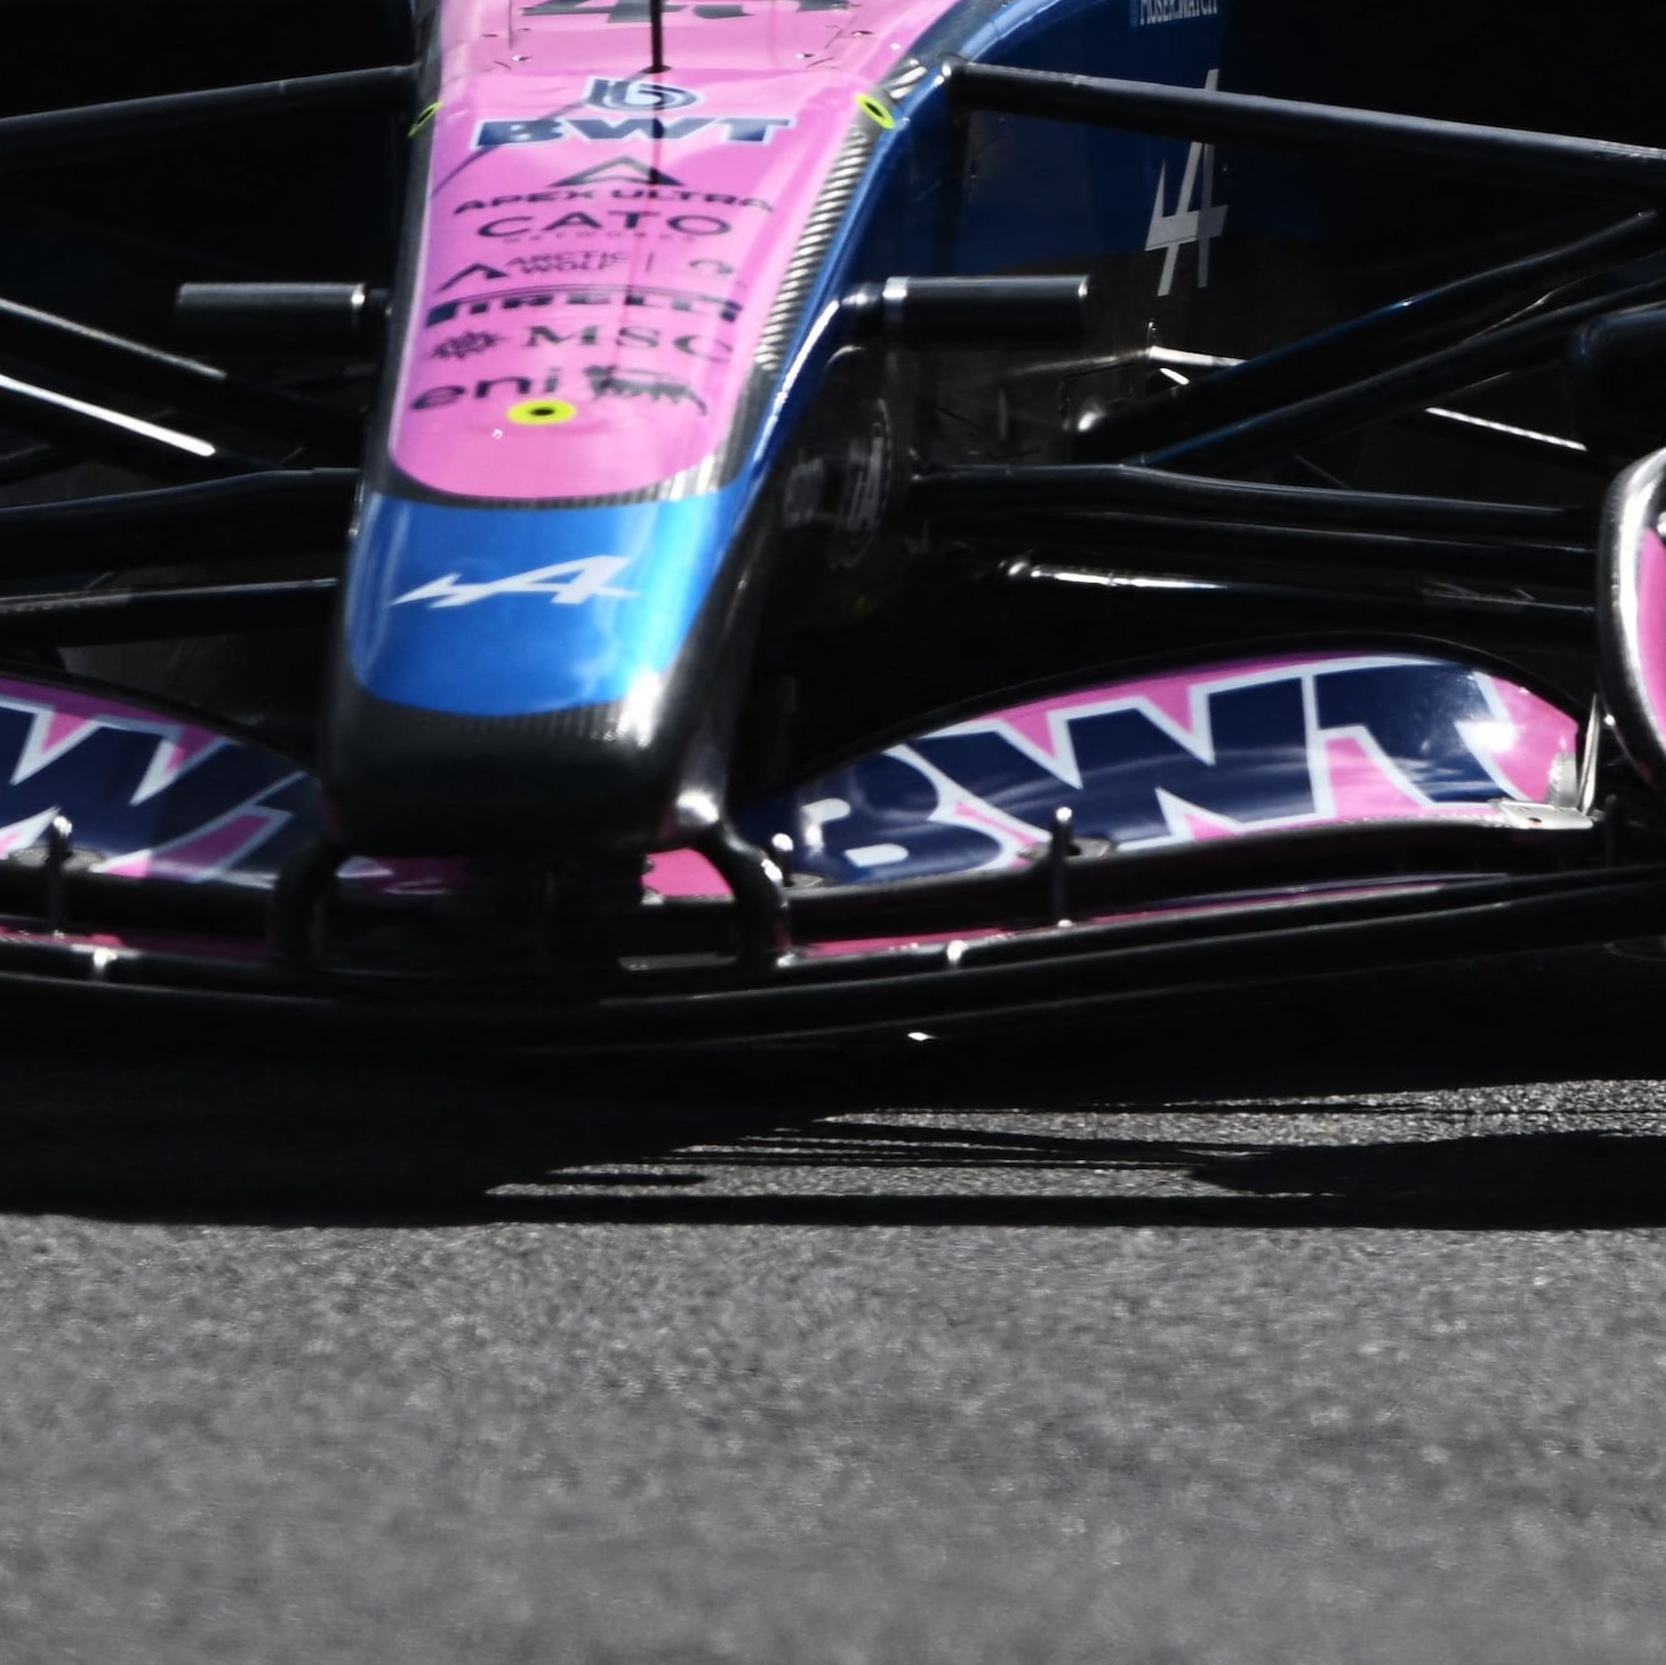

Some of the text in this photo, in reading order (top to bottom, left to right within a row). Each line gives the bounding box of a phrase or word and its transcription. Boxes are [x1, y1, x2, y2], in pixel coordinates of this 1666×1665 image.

[471, 117, 795, 150] BWT
[454, 188, 775, 215] APEX ULTRA
[477, 210, 733, 238] CATO
[425, 283, 744, 329] PIRELLI
[525, 325, 735, 365] MSC
[411, 368, 562, 411] eni
[738, 656, 1518, 884] BWT
